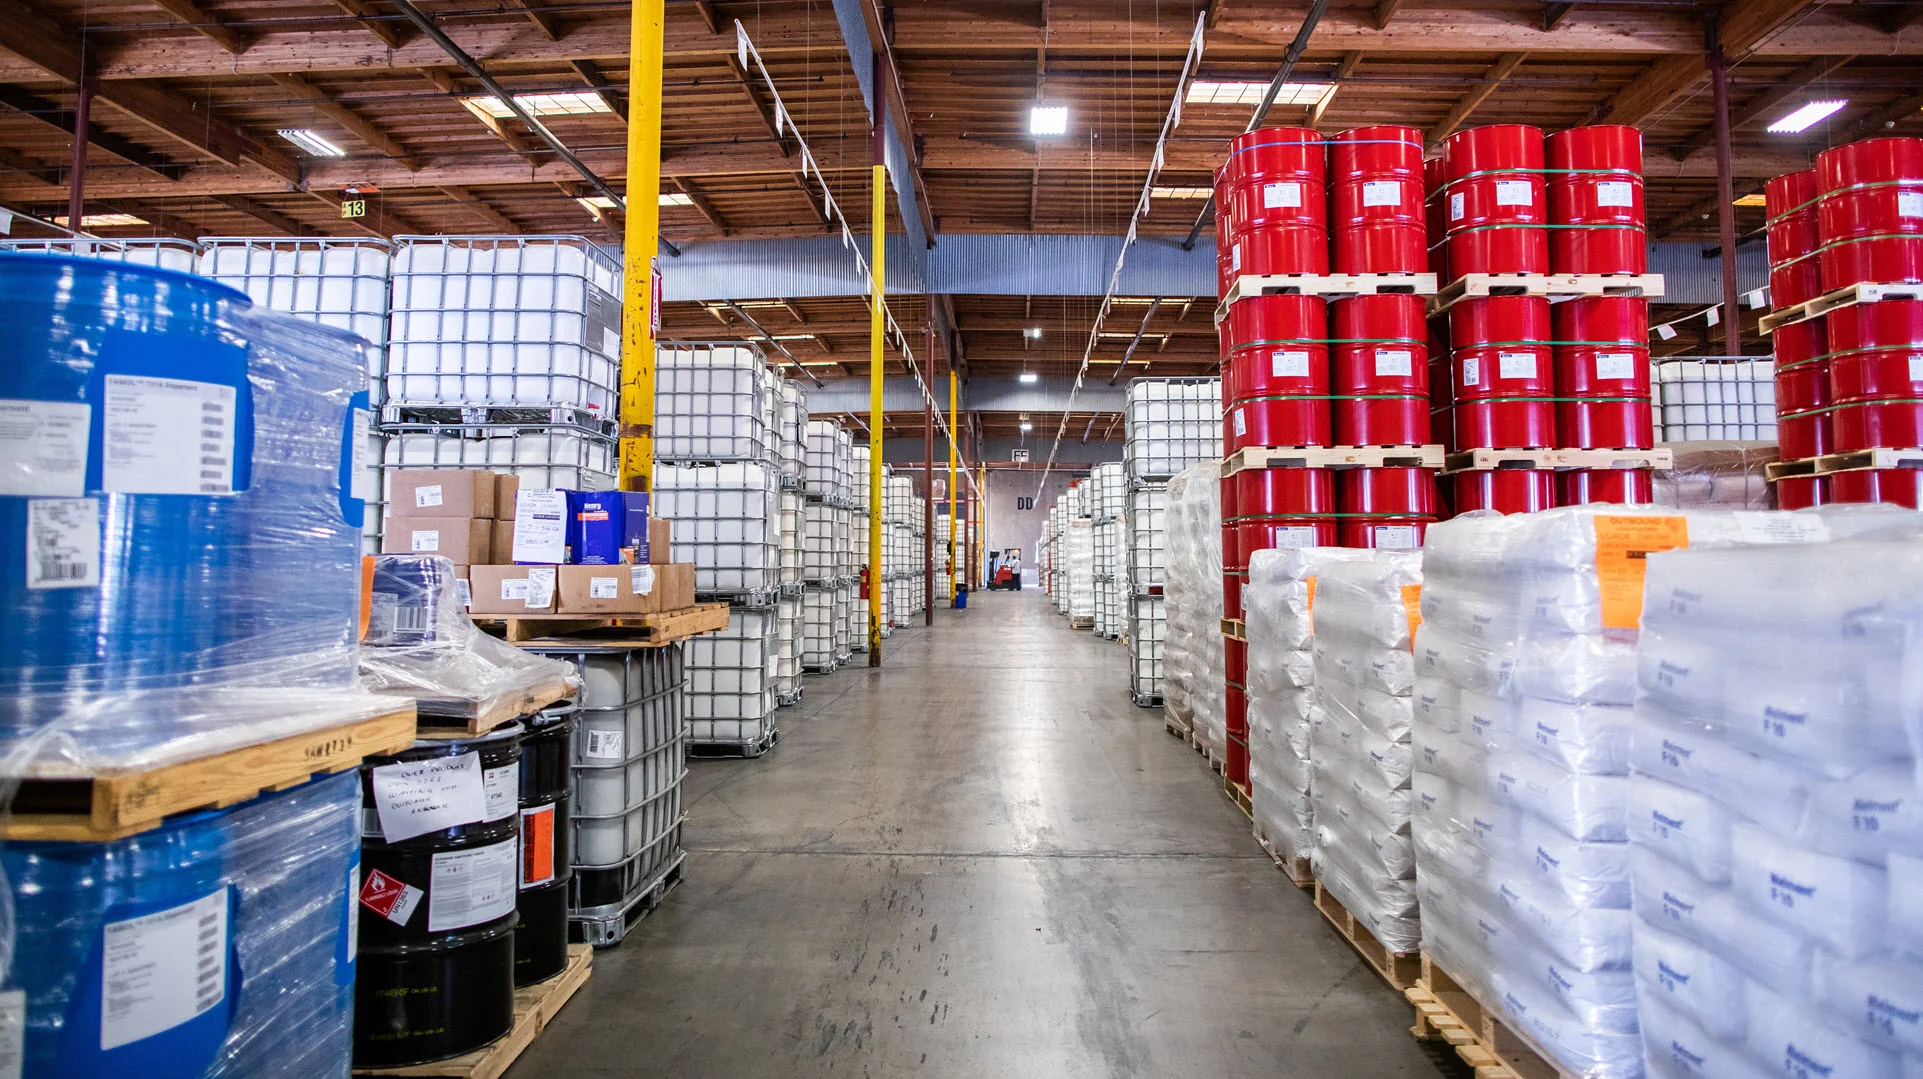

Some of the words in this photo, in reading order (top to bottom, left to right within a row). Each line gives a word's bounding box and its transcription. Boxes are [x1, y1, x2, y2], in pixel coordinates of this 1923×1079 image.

[348, 202, 363, 216] 13
[1018, 496, 1033, 510] DD
[393, 891, 408, 914] UN1263
